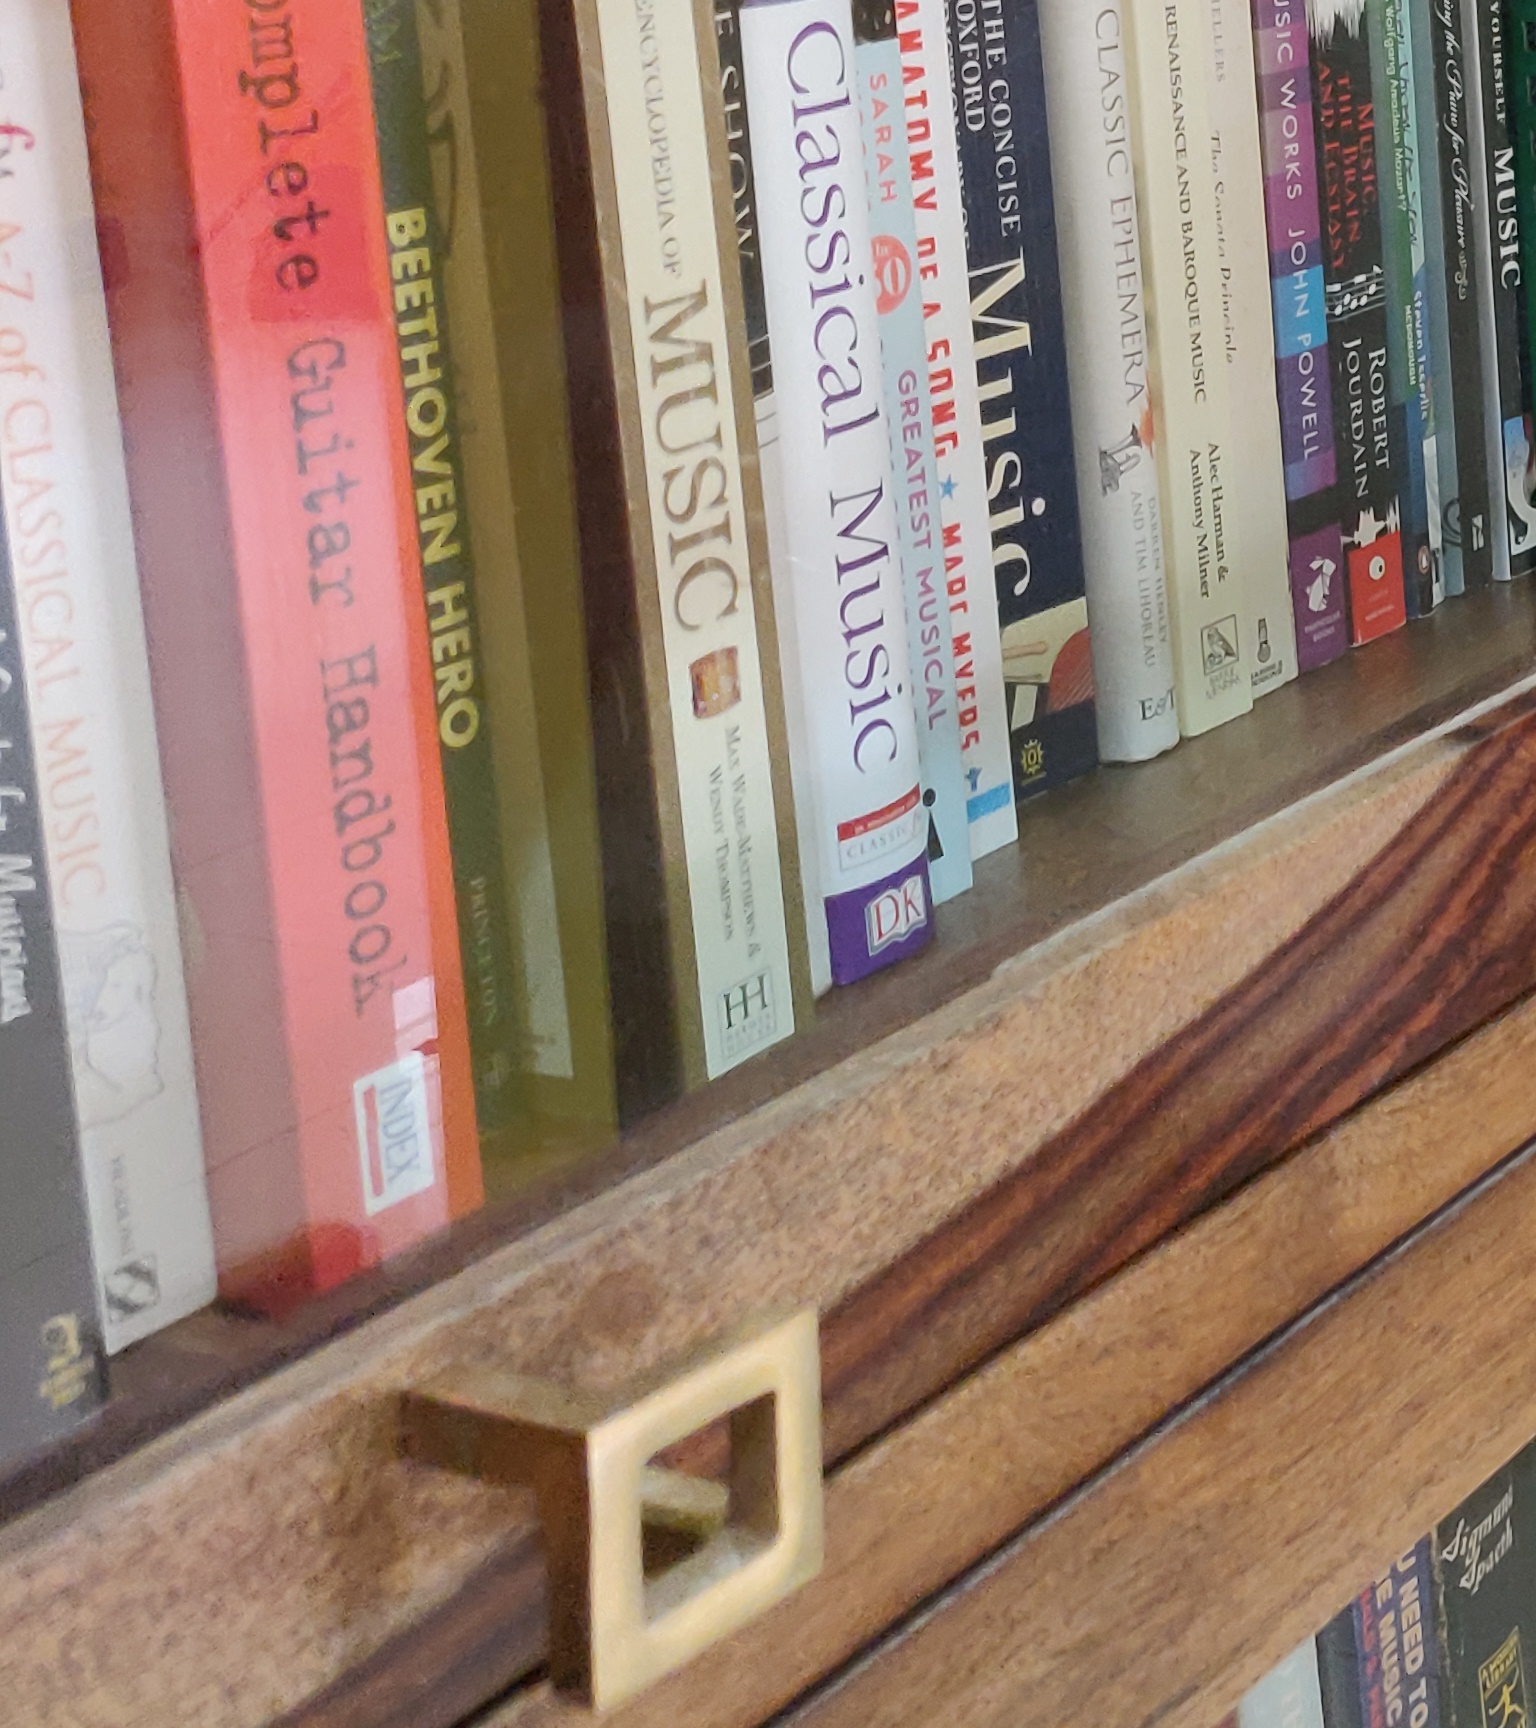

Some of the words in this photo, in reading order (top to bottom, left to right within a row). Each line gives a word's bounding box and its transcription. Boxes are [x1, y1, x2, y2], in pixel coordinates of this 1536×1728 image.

[1094, 8, 1130, 179] CLASSIC
[1163, 5, 1189, 163] RENAISSANCE
[1384, 6, 1399, 76] Wolfgang
[1444, 24, 1460, 57] the
[1444, 59, 1465, 129] Piano
[718, 64, 755, 260] SHOW
[869, 72, 897, 204] SARAH
[986, 81, 1024, 238] CONCISE
[1176, 164, 1192, 215] AND
[1278, 78, 1303, 201] WORKS
[660, 245, 684, 279] OF
[785, 18, 881, 447] Classical
[1180, 218, 1203, 329] BAROQUE
[1286, 228, 1312, 318] JOHN
[1493, 145, 1521, 291] MUSIC
[0, 327, 47, 385] of
[1110, 196, 1146, 407] EPHEMERA
[968, 245, 1046, 598] Music
[1189, 333, 1208, 406] MUSIC
[1295, 333, 1322, 461] POWELL
[1342, 336, 1370, 500] JOURDAIN
[1368, 346, 1392, 471] ROBERT
[286, 335, 356, 610] Guitar
[385, 207, 461, 566] BEETHOVEN
[423, 582, 481, 748] HERO
[643, 278, 739, 632] MUSIC
[1189, 448, 1208, 530] Anthony
[1207, 442, 1221, 484] Alec
[3, 394, 78, 705] CLASSICAL
[898, 369, 932, 550] GREATEST
[916, 566, 947, 731] MUSICAL
[1195, 533, 1212, 600] Milner
[1210, 484, 1228, 563] Harman
[1216, 564, 1229, 584] &
[829, 478, 904, 775] Music
[42, 716, 107, 906] MUSIC
[320, 642, 409, 1018] Handbook
[874, 885, 922, 942] DK
[1377, 1609, 1403, 1728] MUSIC
[1398, 1575, 1425, 1675] NEED
[1408, 1676, 1429, 1728] TO
